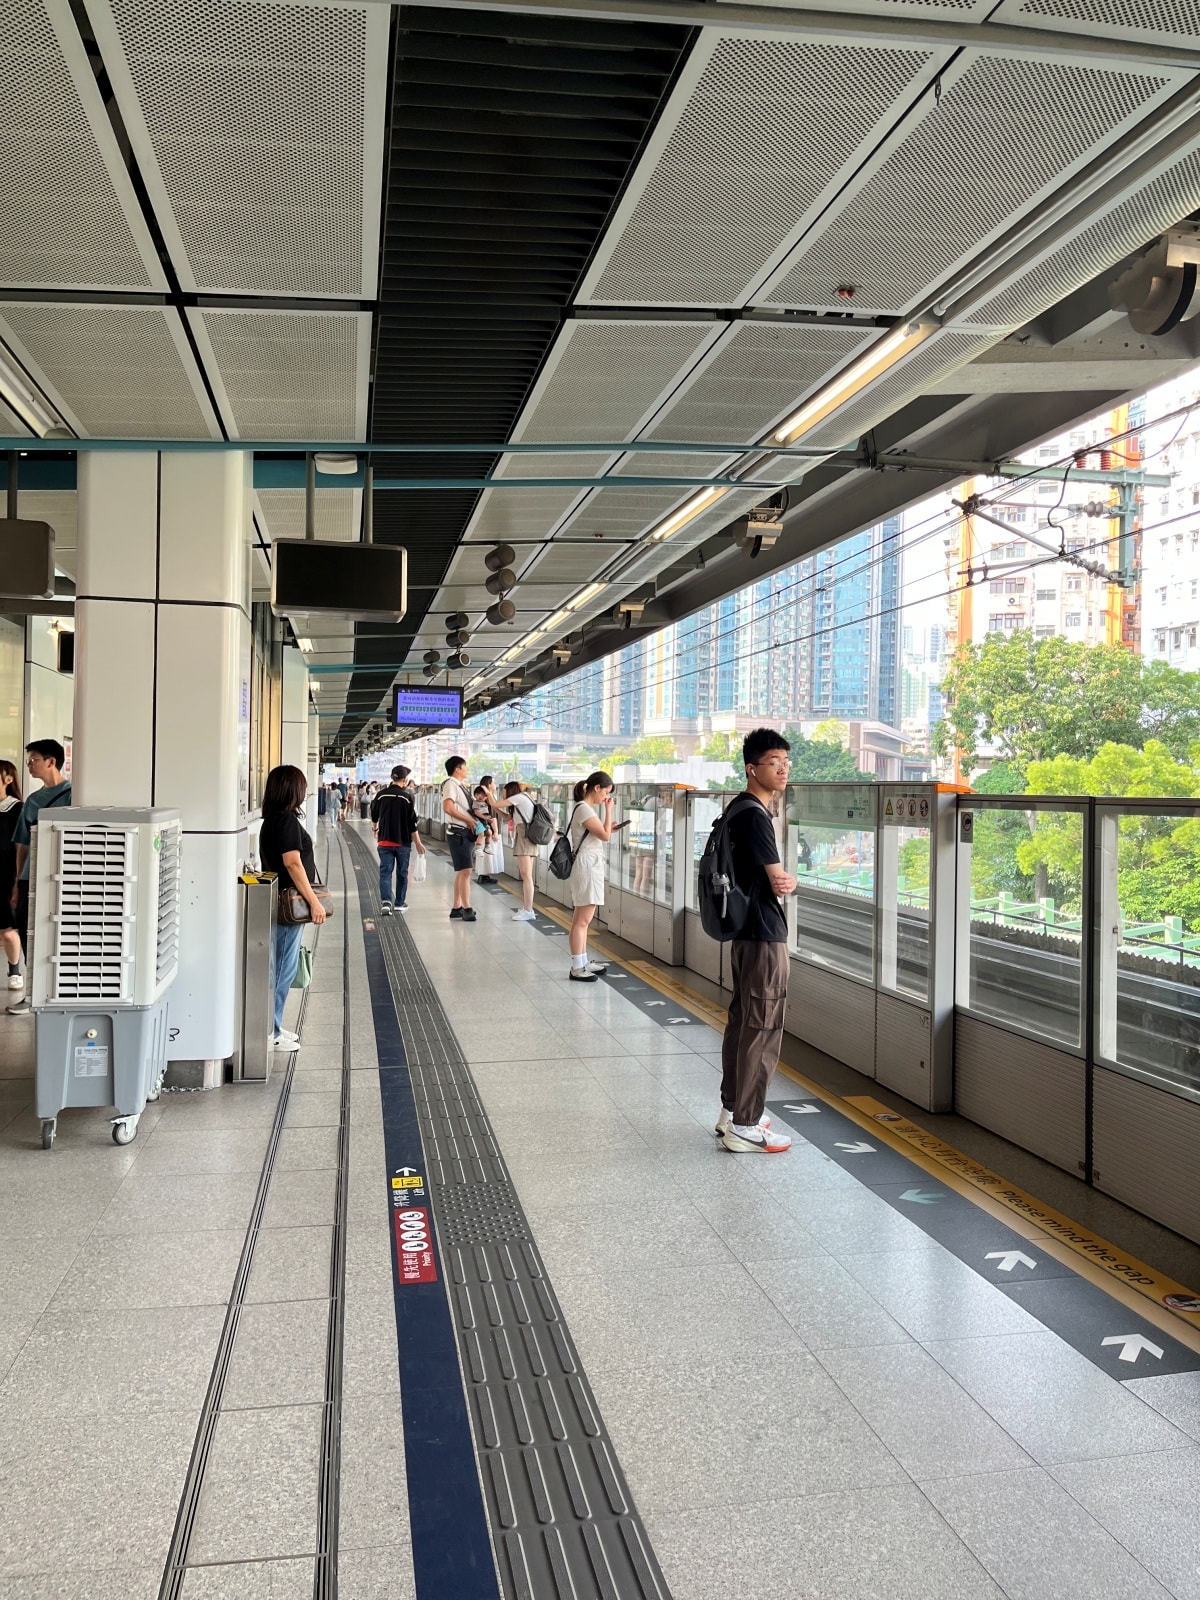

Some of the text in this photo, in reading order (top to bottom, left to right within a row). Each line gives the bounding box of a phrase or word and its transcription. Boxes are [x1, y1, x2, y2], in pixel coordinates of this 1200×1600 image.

[996, 1190, 1155, 1286] Please mind the gap
